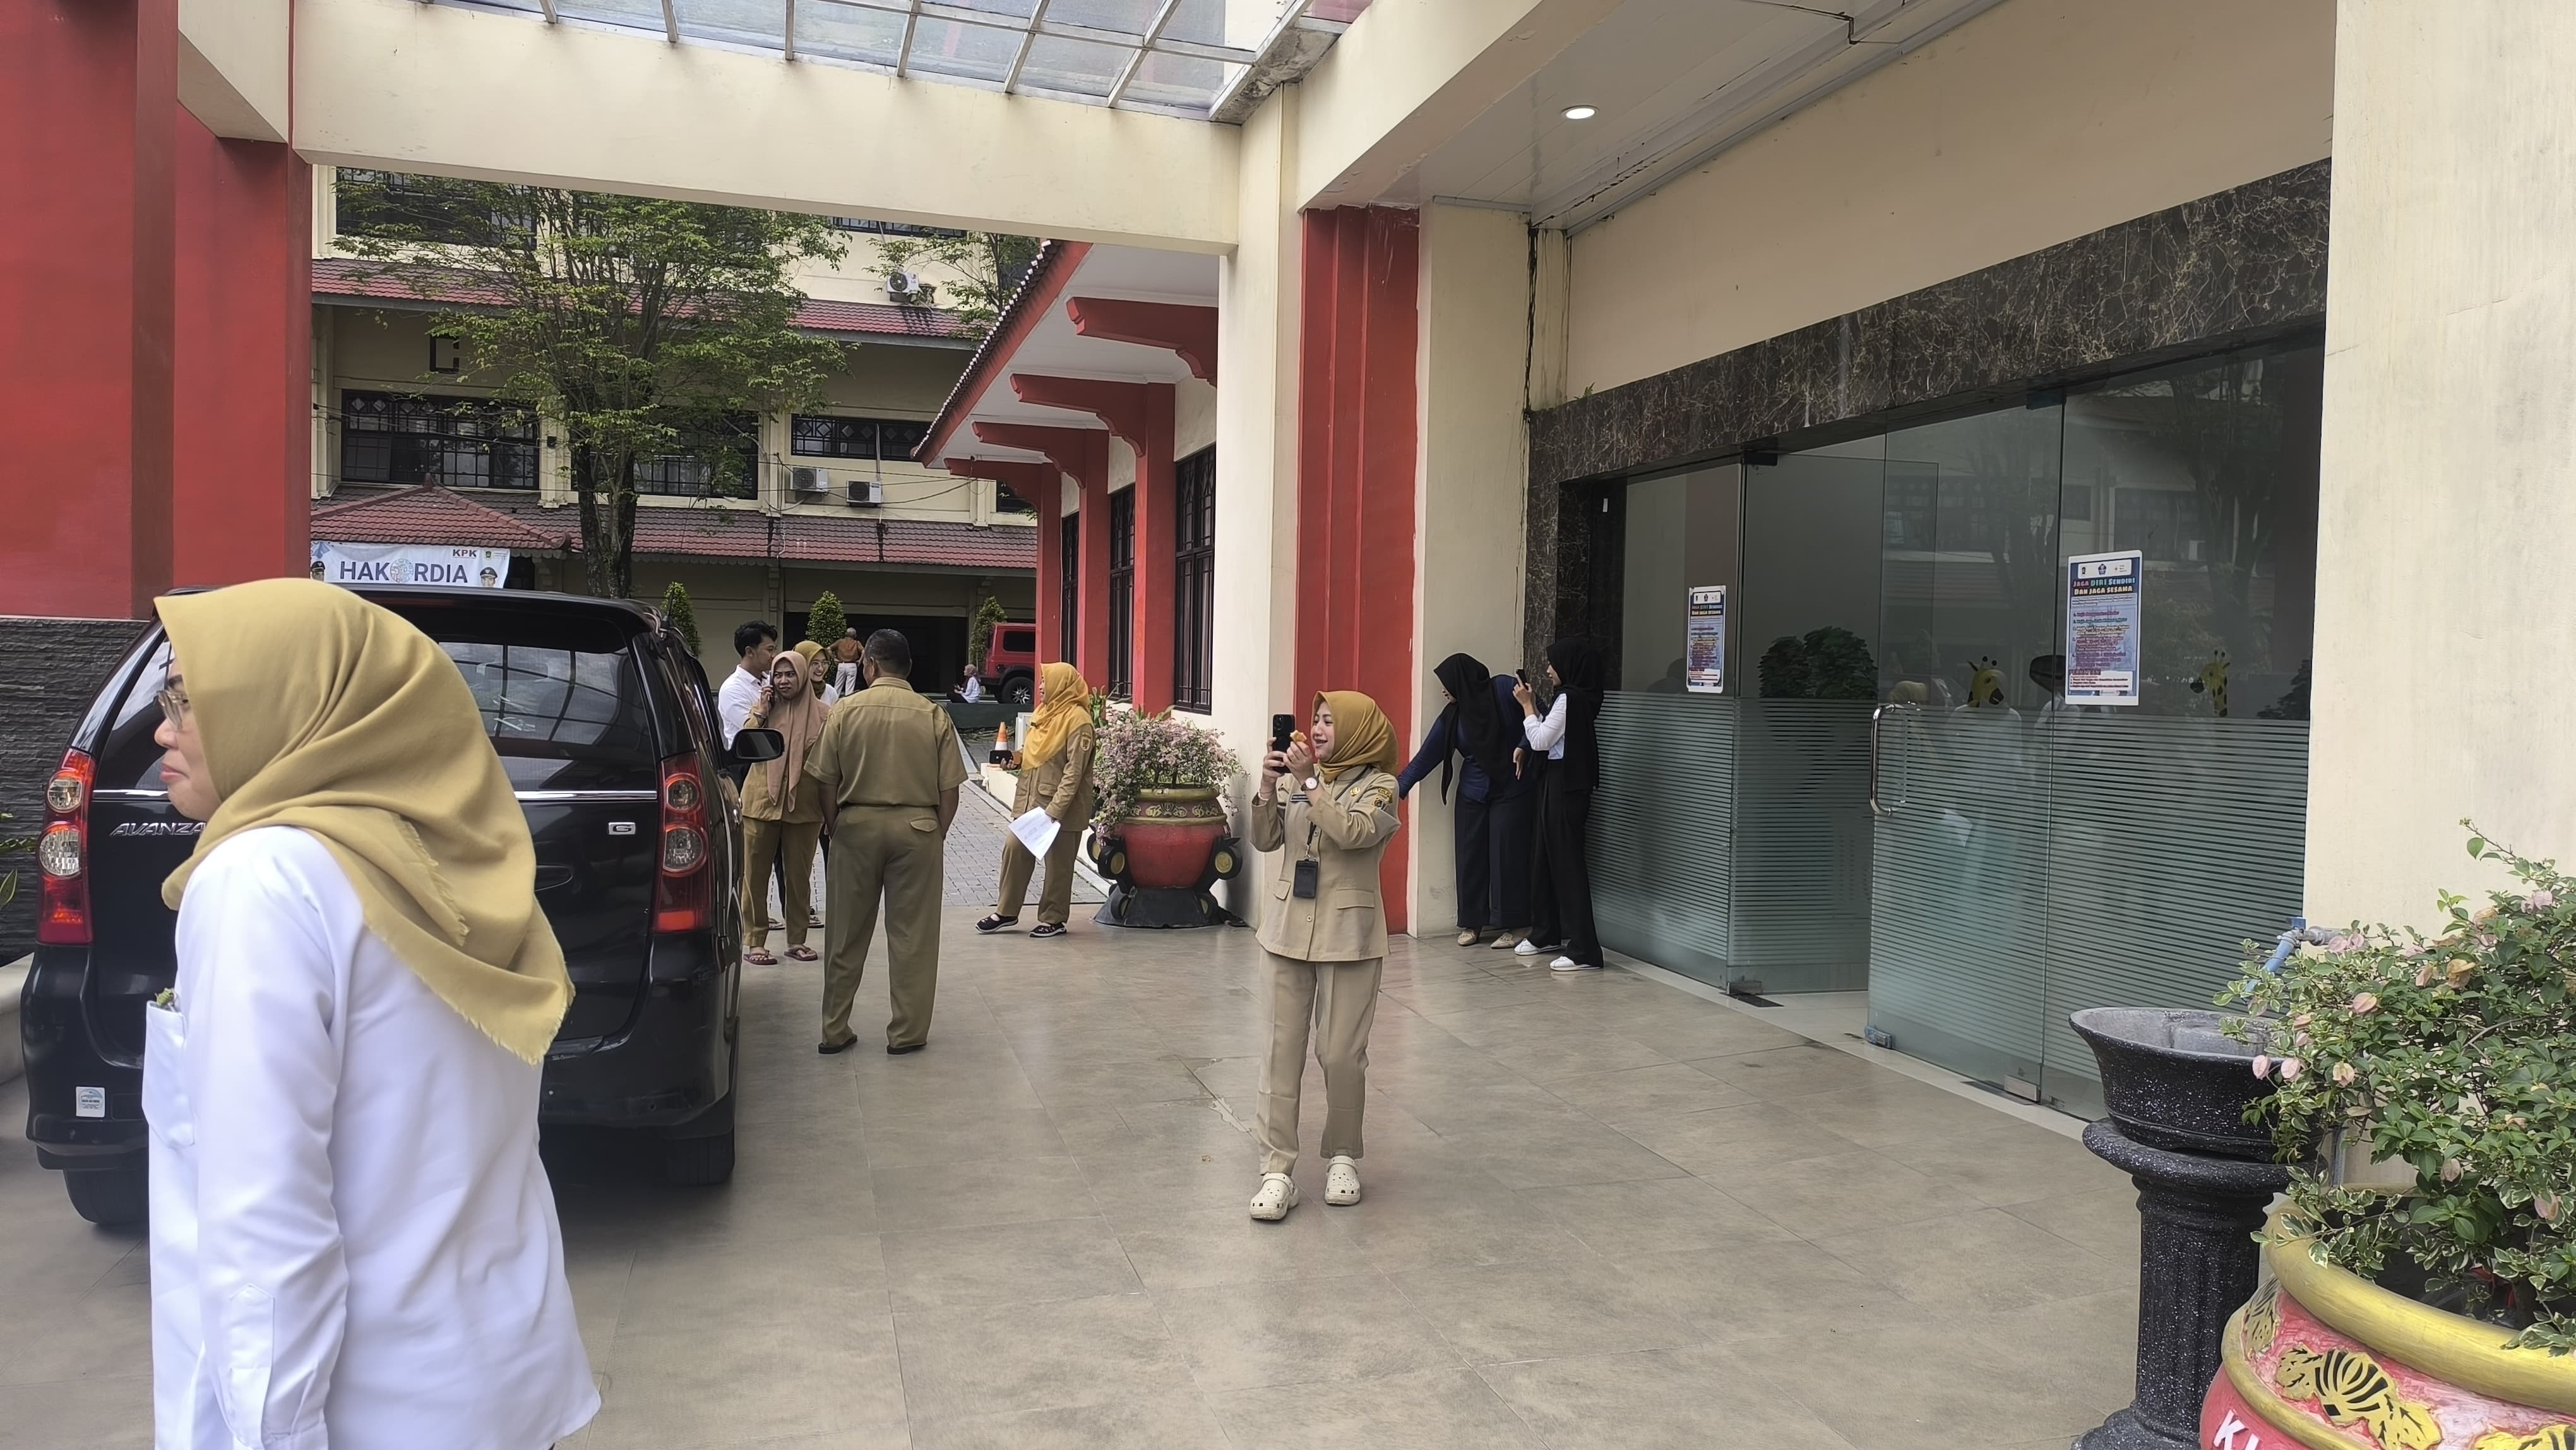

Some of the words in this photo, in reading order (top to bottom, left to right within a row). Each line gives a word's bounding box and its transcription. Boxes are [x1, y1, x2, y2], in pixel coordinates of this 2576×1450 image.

[452, 549, 477, 557] KPK
[109, 822, 207, 836] AVANZA
[612, 823, 633, 833] G
